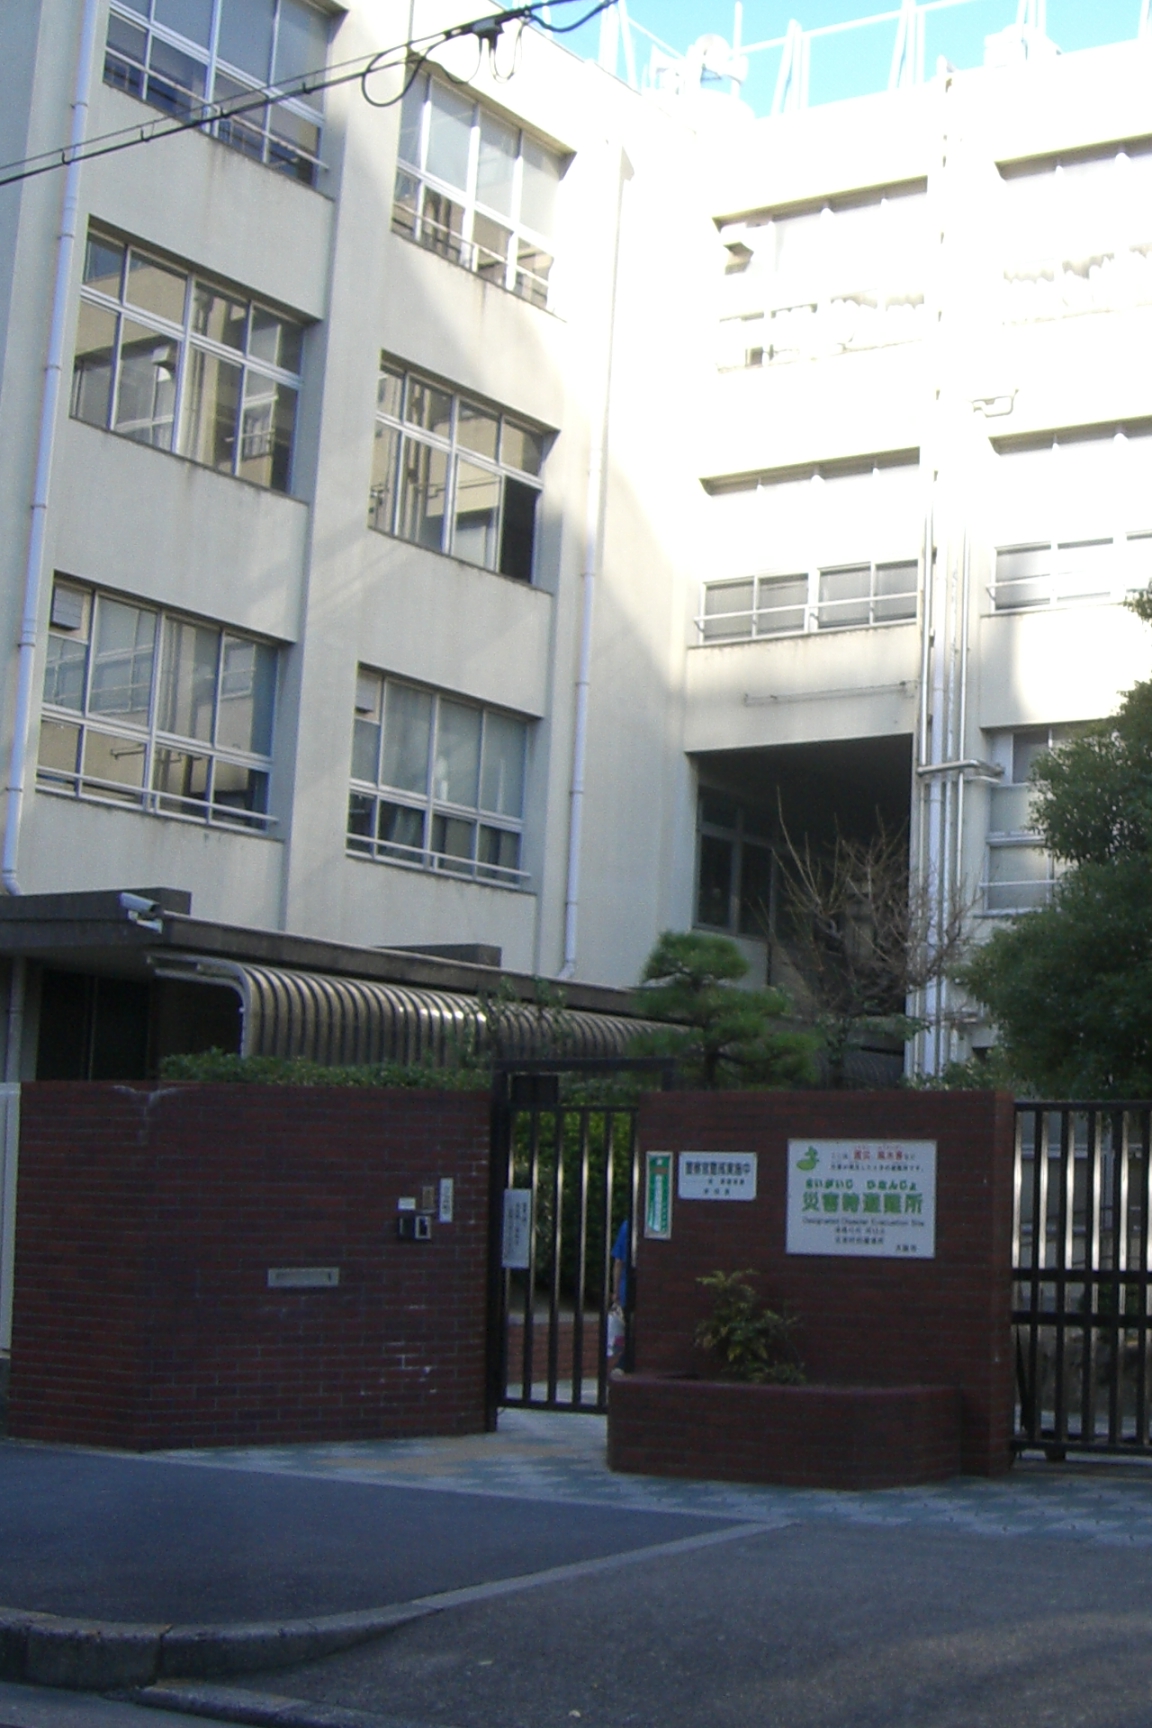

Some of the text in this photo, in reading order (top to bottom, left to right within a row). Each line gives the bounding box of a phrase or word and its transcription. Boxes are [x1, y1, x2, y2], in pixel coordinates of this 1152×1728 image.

[801, 1191, 924, 1214] 災害時避難所
